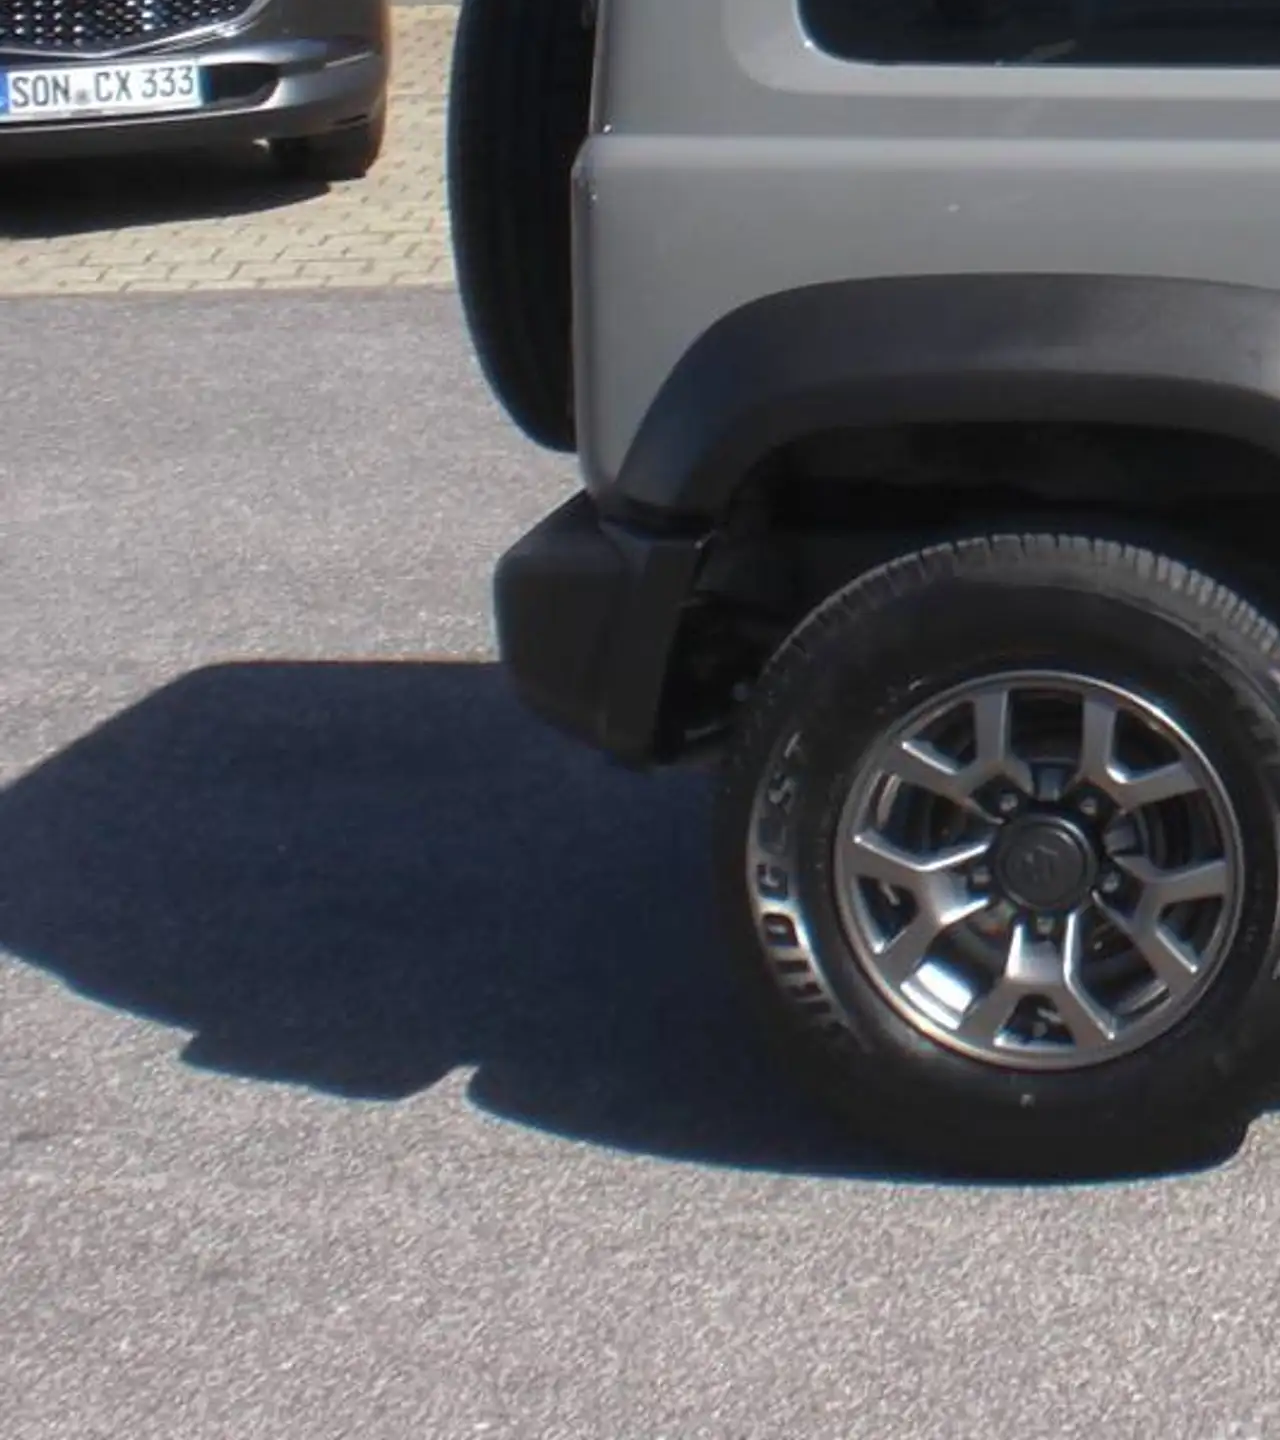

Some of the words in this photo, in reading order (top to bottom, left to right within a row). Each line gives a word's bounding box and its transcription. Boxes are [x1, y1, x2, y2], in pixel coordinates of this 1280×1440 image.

[11, 74, 71, 108] SON
[94, 69, 132, 102] CX
[141, 65, 194, 98] 333
